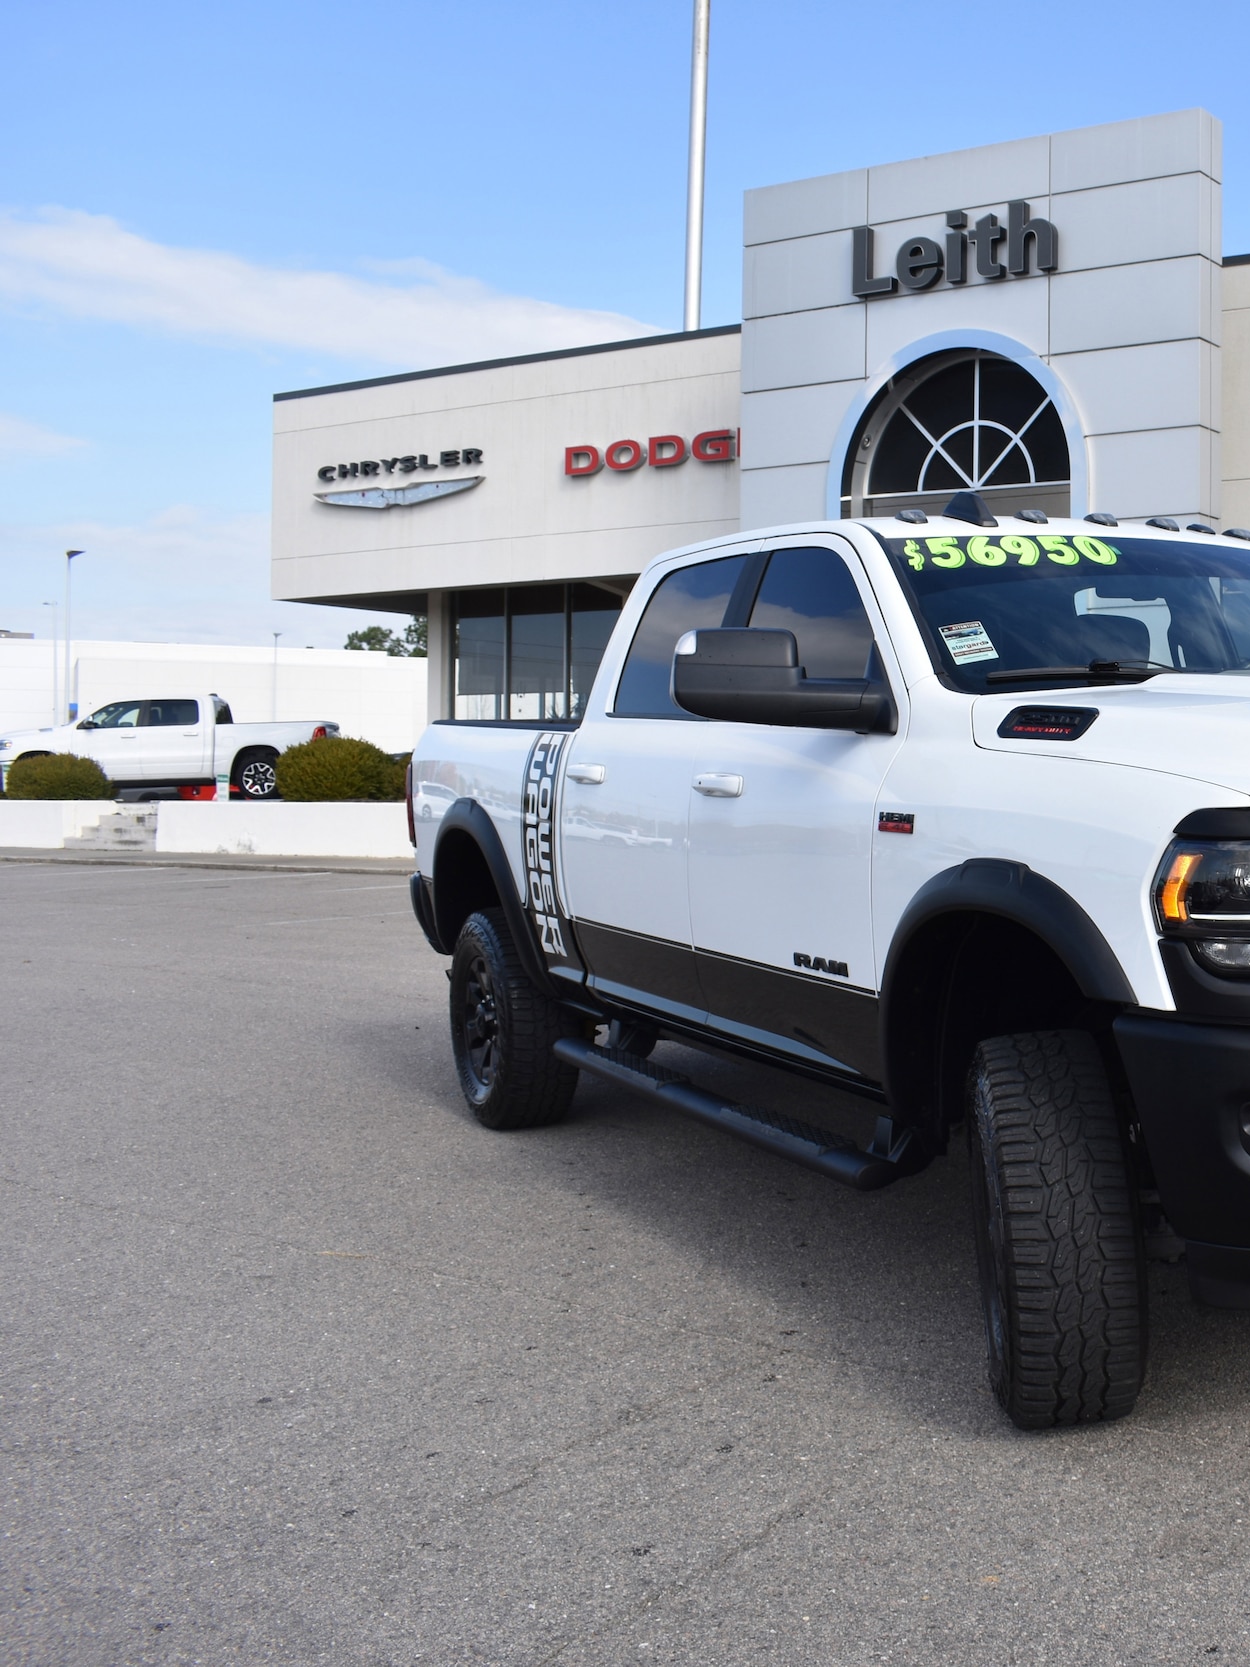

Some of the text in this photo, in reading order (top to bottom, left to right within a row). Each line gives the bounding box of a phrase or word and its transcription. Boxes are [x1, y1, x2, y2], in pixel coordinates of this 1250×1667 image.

[852, 200, 1058, 297] Leith
[317, 447, 484, 482] CHRYSLER
[564, 426, 741, 478] DODG
[903, 535, 1118, 571] $56950
[879, 811, 914, 824] HEMI
[525, 733, 556, 955] WAGON
[537, 734, 567, 957] POWER
[793, 951, 849, 978] RAM
